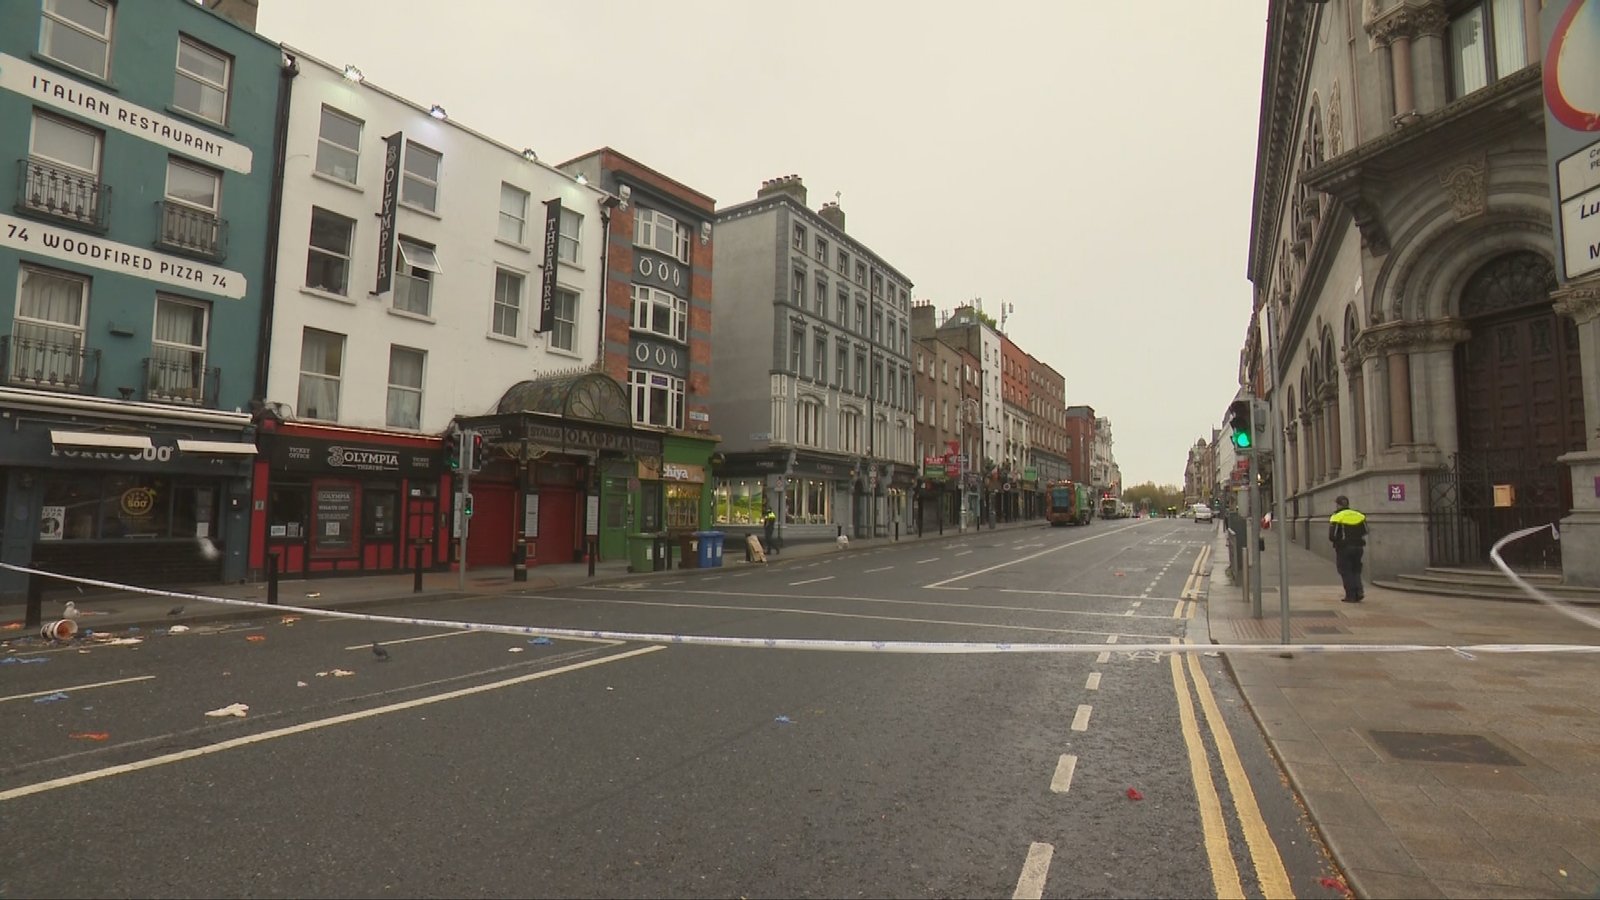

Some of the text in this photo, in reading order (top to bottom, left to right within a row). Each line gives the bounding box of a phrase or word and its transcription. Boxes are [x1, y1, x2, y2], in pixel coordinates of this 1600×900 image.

[33, 75, 224, 157] ITALIAN RESTAURANT
[7, 223, 227, 289] 74 WOODFIRED PIZZA 74
[379, 168, 395, 278] OLYMPIA
[543, 218, 556, 310] THEATRE
[344, 451, 399, 466] OLYMPIA
